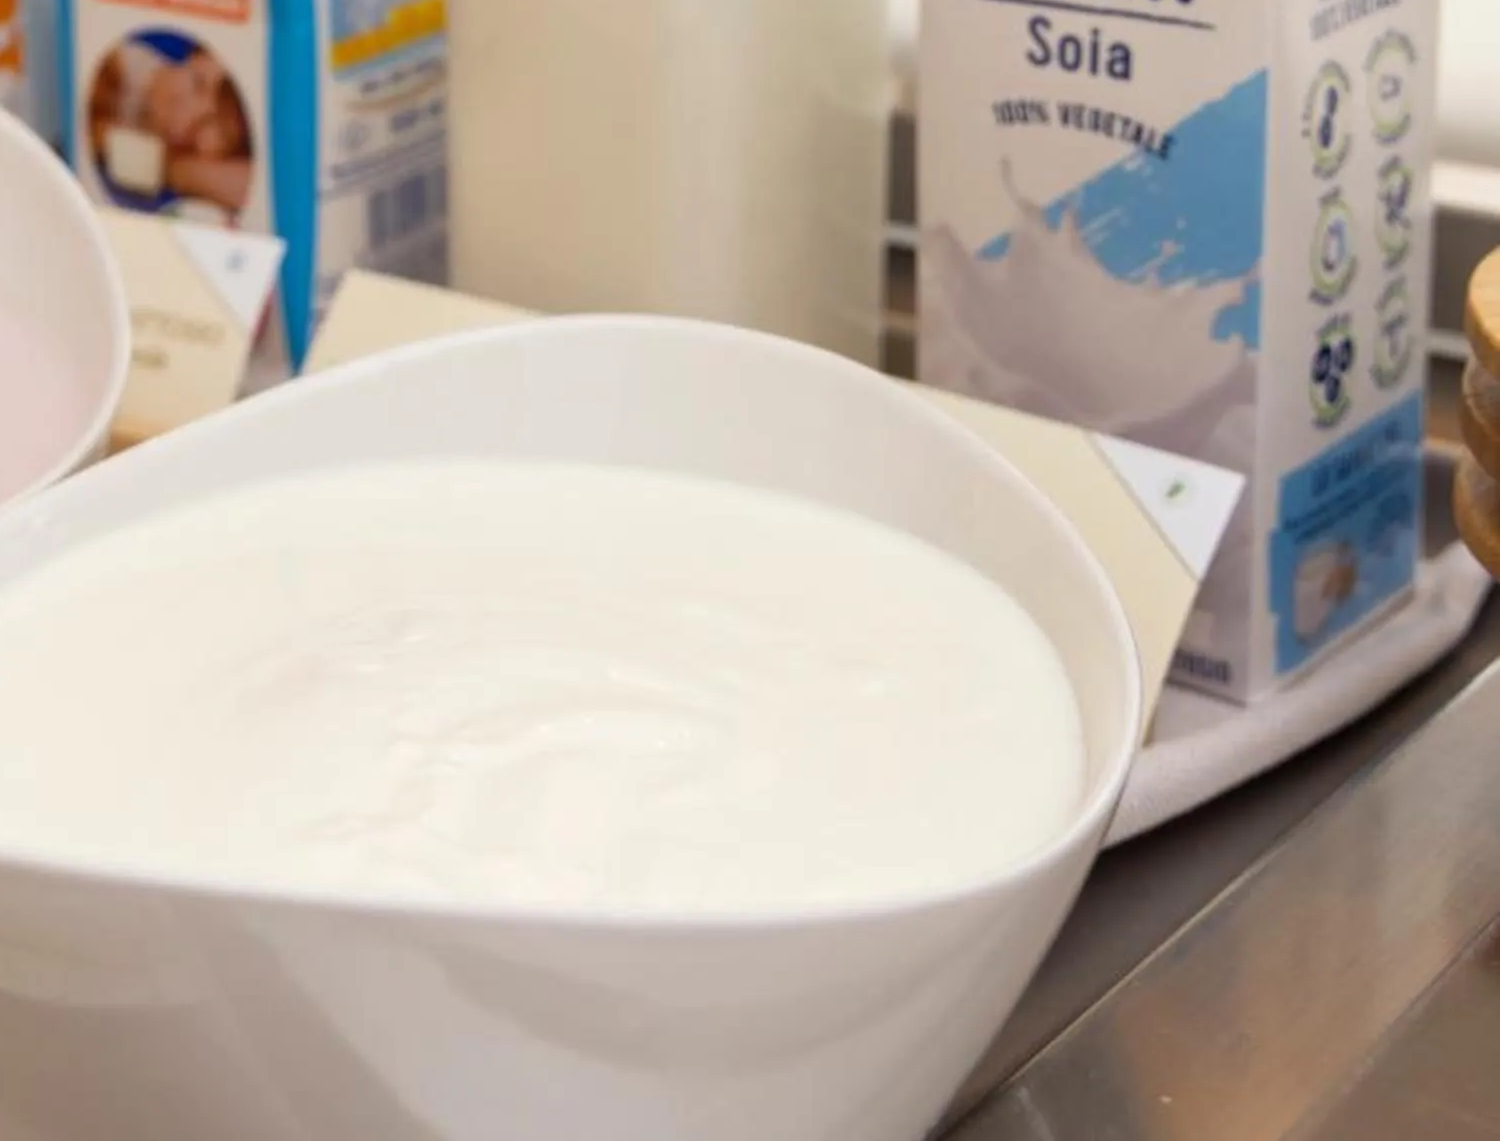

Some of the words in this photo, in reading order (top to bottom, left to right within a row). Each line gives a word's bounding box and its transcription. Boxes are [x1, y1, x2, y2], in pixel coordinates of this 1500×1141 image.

[1027, 16, 1134, 81] Soia
[991, 99, 1049, 126] 100%
[1055, 100, 1177, 160] VEGETALE
